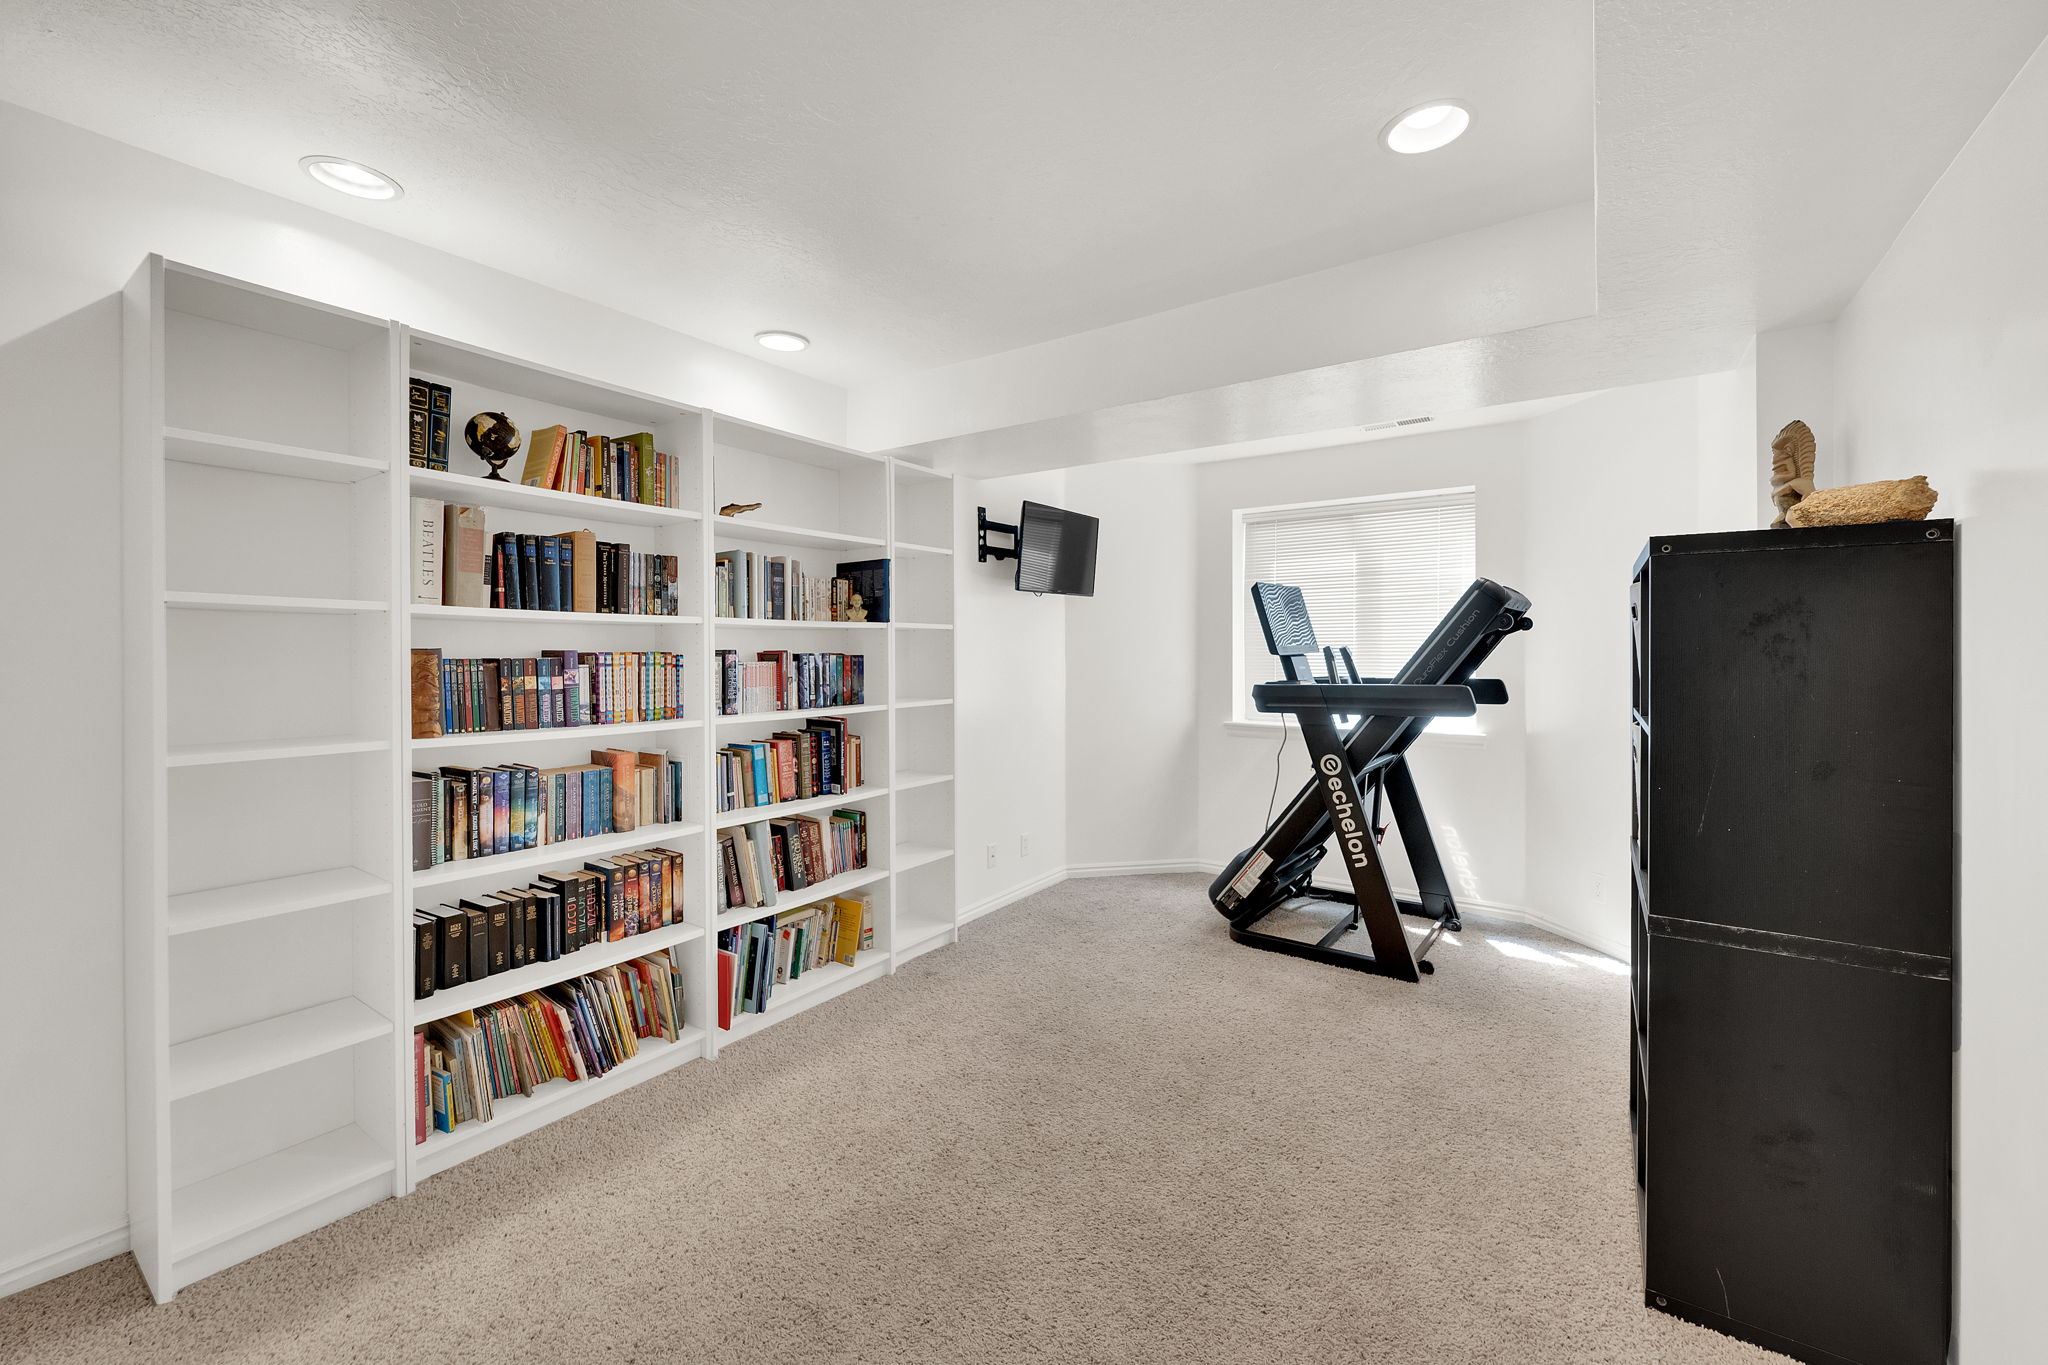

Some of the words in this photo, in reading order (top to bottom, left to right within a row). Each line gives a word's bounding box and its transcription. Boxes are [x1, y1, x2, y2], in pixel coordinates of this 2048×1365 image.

[422, 519, 434, 586] BEATLES
[1447, 609, 1480, 647] Cushion
[1328, 777, 1368, 868] echelon
